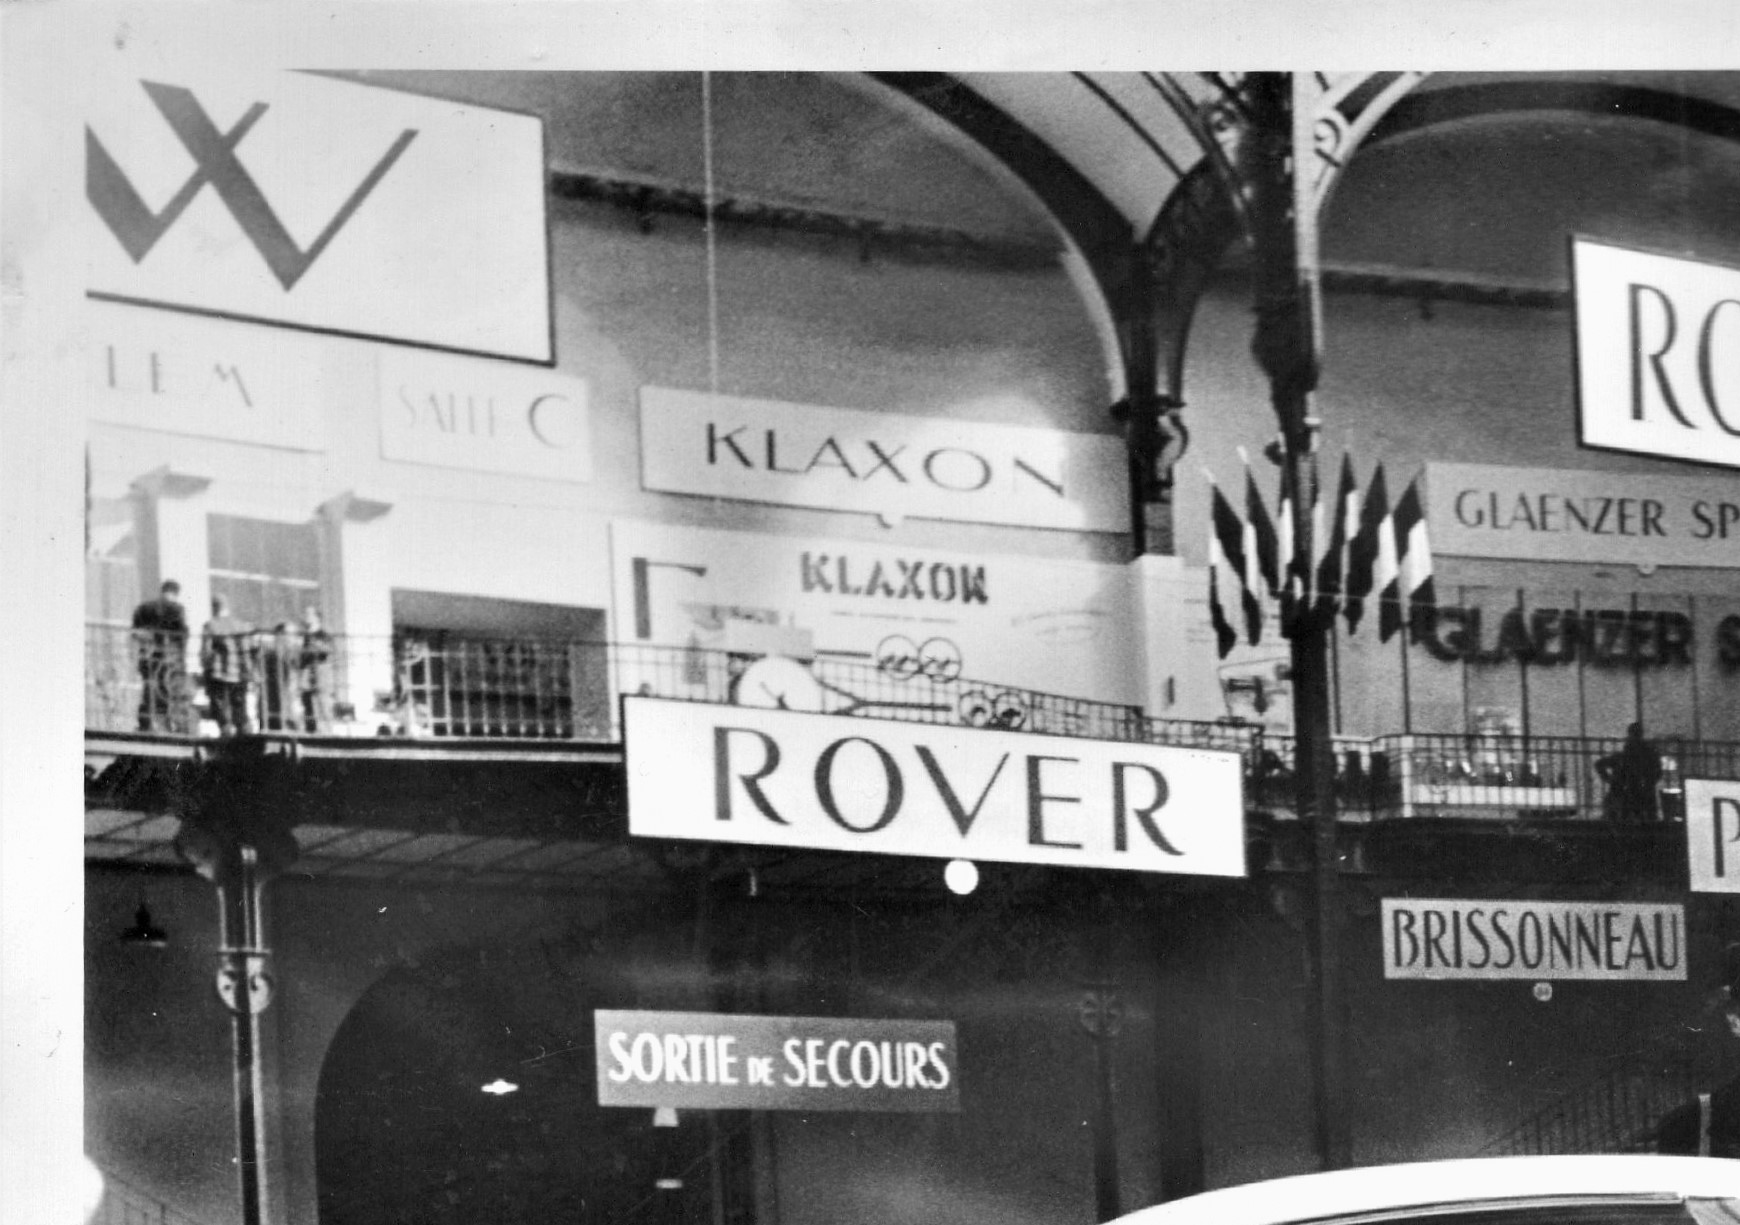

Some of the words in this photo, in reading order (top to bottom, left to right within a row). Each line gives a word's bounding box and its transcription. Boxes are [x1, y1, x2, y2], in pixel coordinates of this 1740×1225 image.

[705, 422, 1065, 498] KLAXON
[1454, 488, 1666, 537] GLAENZER
[801, 551, 989, 605] KLAXON
[1425, 606, 1694, 670] GLAENZER
[713, 726, 1186, 857] ROVER
[1395, 908, 1680, 973] BRISSONNEAU
[608, 1031, 740, 1086] SORTIE
[747, 1056, 776, 1087] DE
[783, 1038, 951, 1090] SECOURS
